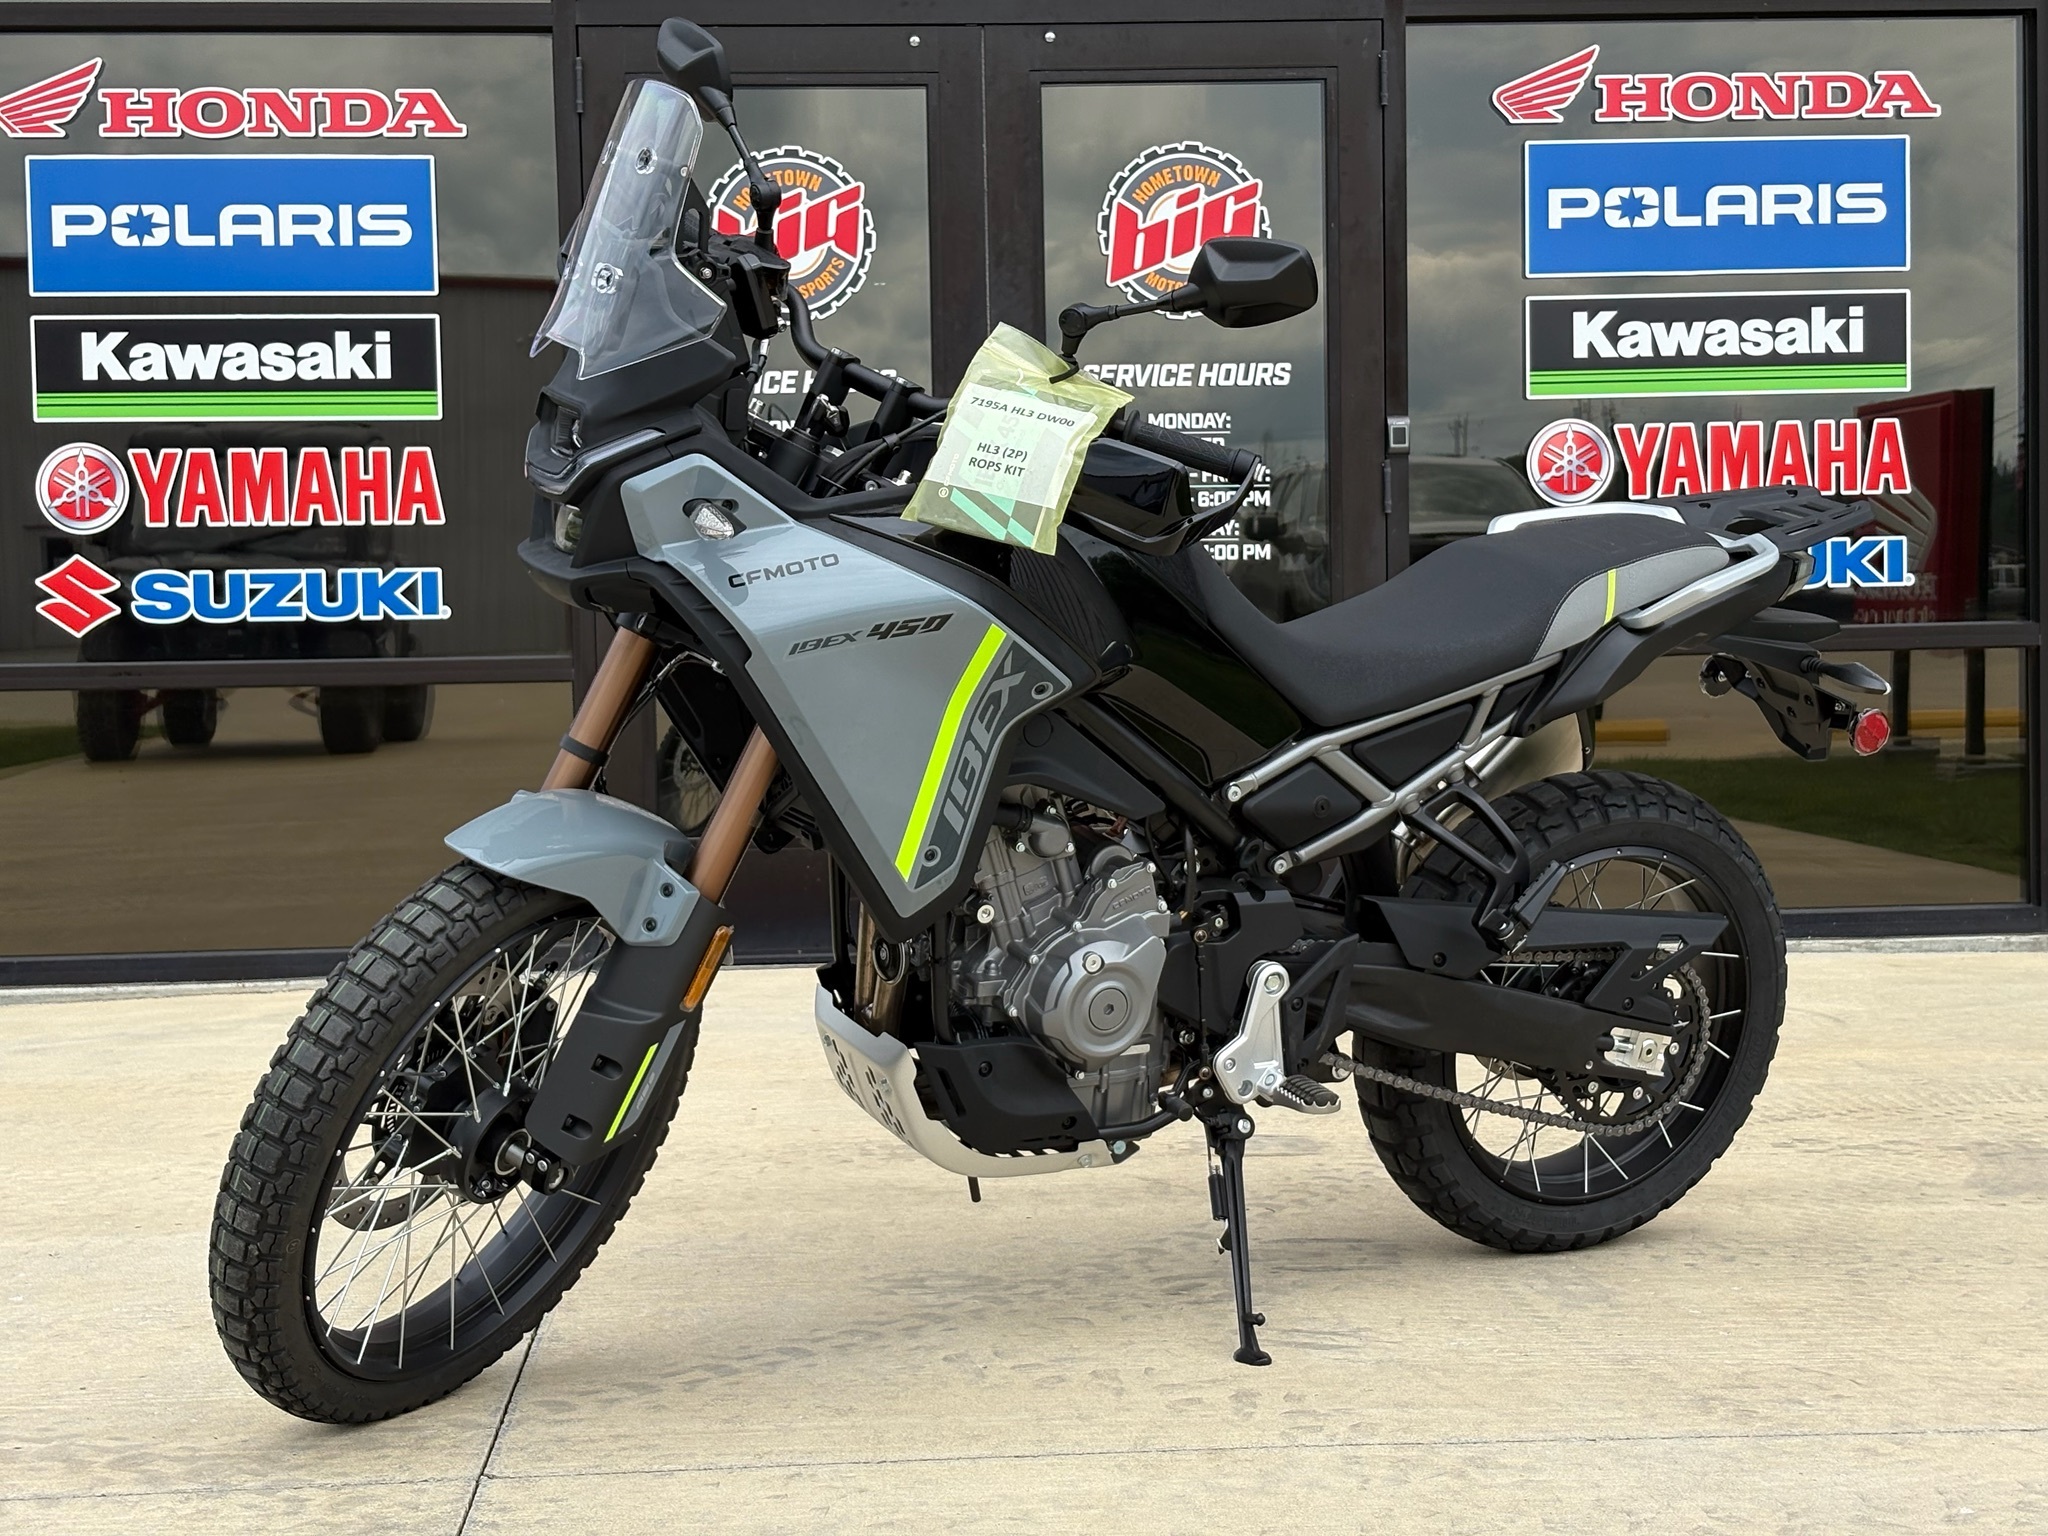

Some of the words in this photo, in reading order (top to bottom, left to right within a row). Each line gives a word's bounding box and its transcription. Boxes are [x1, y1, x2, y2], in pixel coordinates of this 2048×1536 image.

[99, 89, 466, 138] HONDA
[1595, 71, 1941, 122] HONDA
[733, 169, 822, 211] HOTOWN
[1132, 164, 1221, 205] HOMETOWN
[1548, 182, 1887, 229] POLARIS
[51, 204, 413, 248] POLARIS
[798, 257, 845, 299] SPORTS
[1572, 306, 1864, 359] Kawasaki
[81, 331, 391, 382] Kawasaki
[1083, 364, 1195, 387] SERVICE
[1198, 362, 1292, 387] HOURS
[969, 396, 1008, 412] 7195A
[1011, 405, 1035, 418] HL3
[1036, 412, 1076, 427] DW00
[1148, 413, 1231, 429] MONDAY:
[968, 457, 1001, 472] ROPS
[1004, 464, 1026, 478] KIT
[976, 442, 1000, 455] HL3
[1002, 446, 1028, 462] (2P)
[1613, 418, 1911, 499] YAMAHA
[127, 447, 446, 528] YAMAHA
[728, 553, 840, 588] CFMOTO
[1243, 544, 1271, 560] PM
[132, 567, 446, 622] SUZUKI
[788, 630, 863, 656] IBEX
[866, 613, 954, 641] 450
[943, 650, 1027, 835] IBEX
